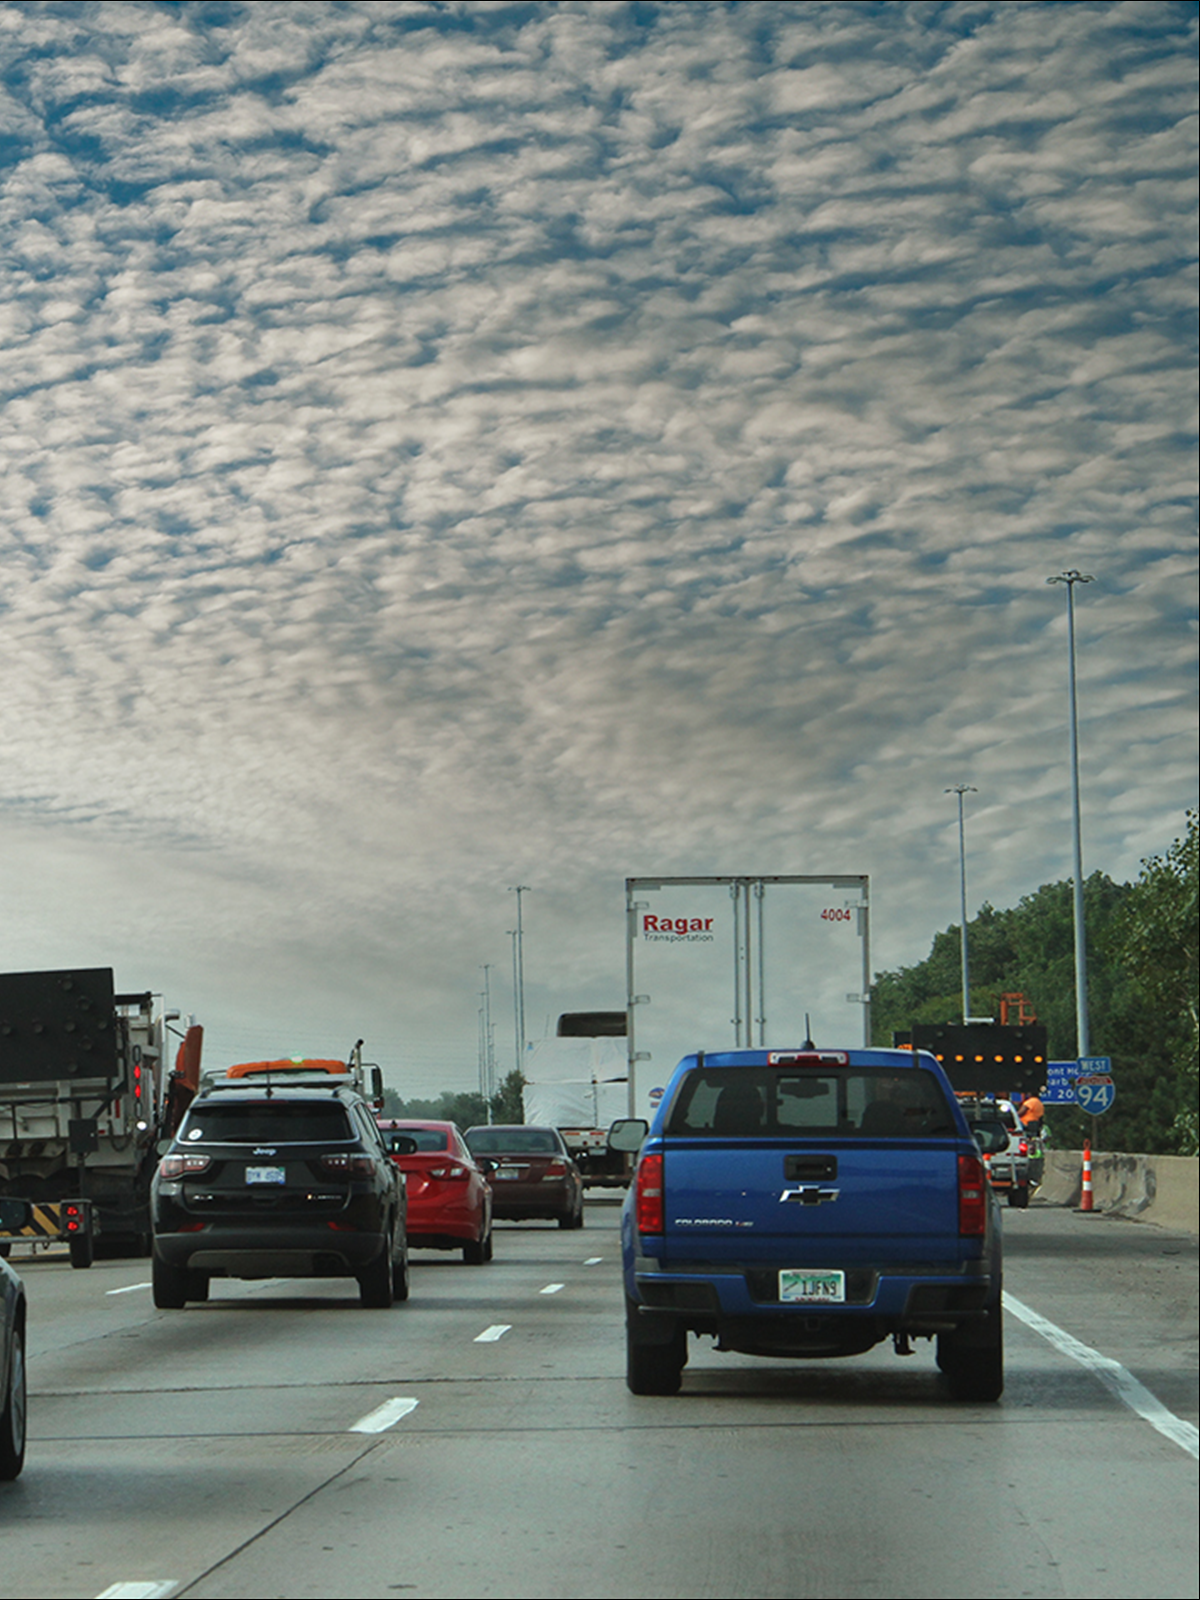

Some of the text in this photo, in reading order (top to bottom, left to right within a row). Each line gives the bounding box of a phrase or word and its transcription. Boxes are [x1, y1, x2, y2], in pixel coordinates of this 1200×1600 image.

[821, 908, 851, 921] 4004
[643, 915, 714, 935] Ragar
[644, 934, 714, 943] Transportation
[1081, 1060, 1106, 1071] WEST
[1078, 1085, 1108, 1106] 94
[252, 1147, 277, 1156] Jeep
